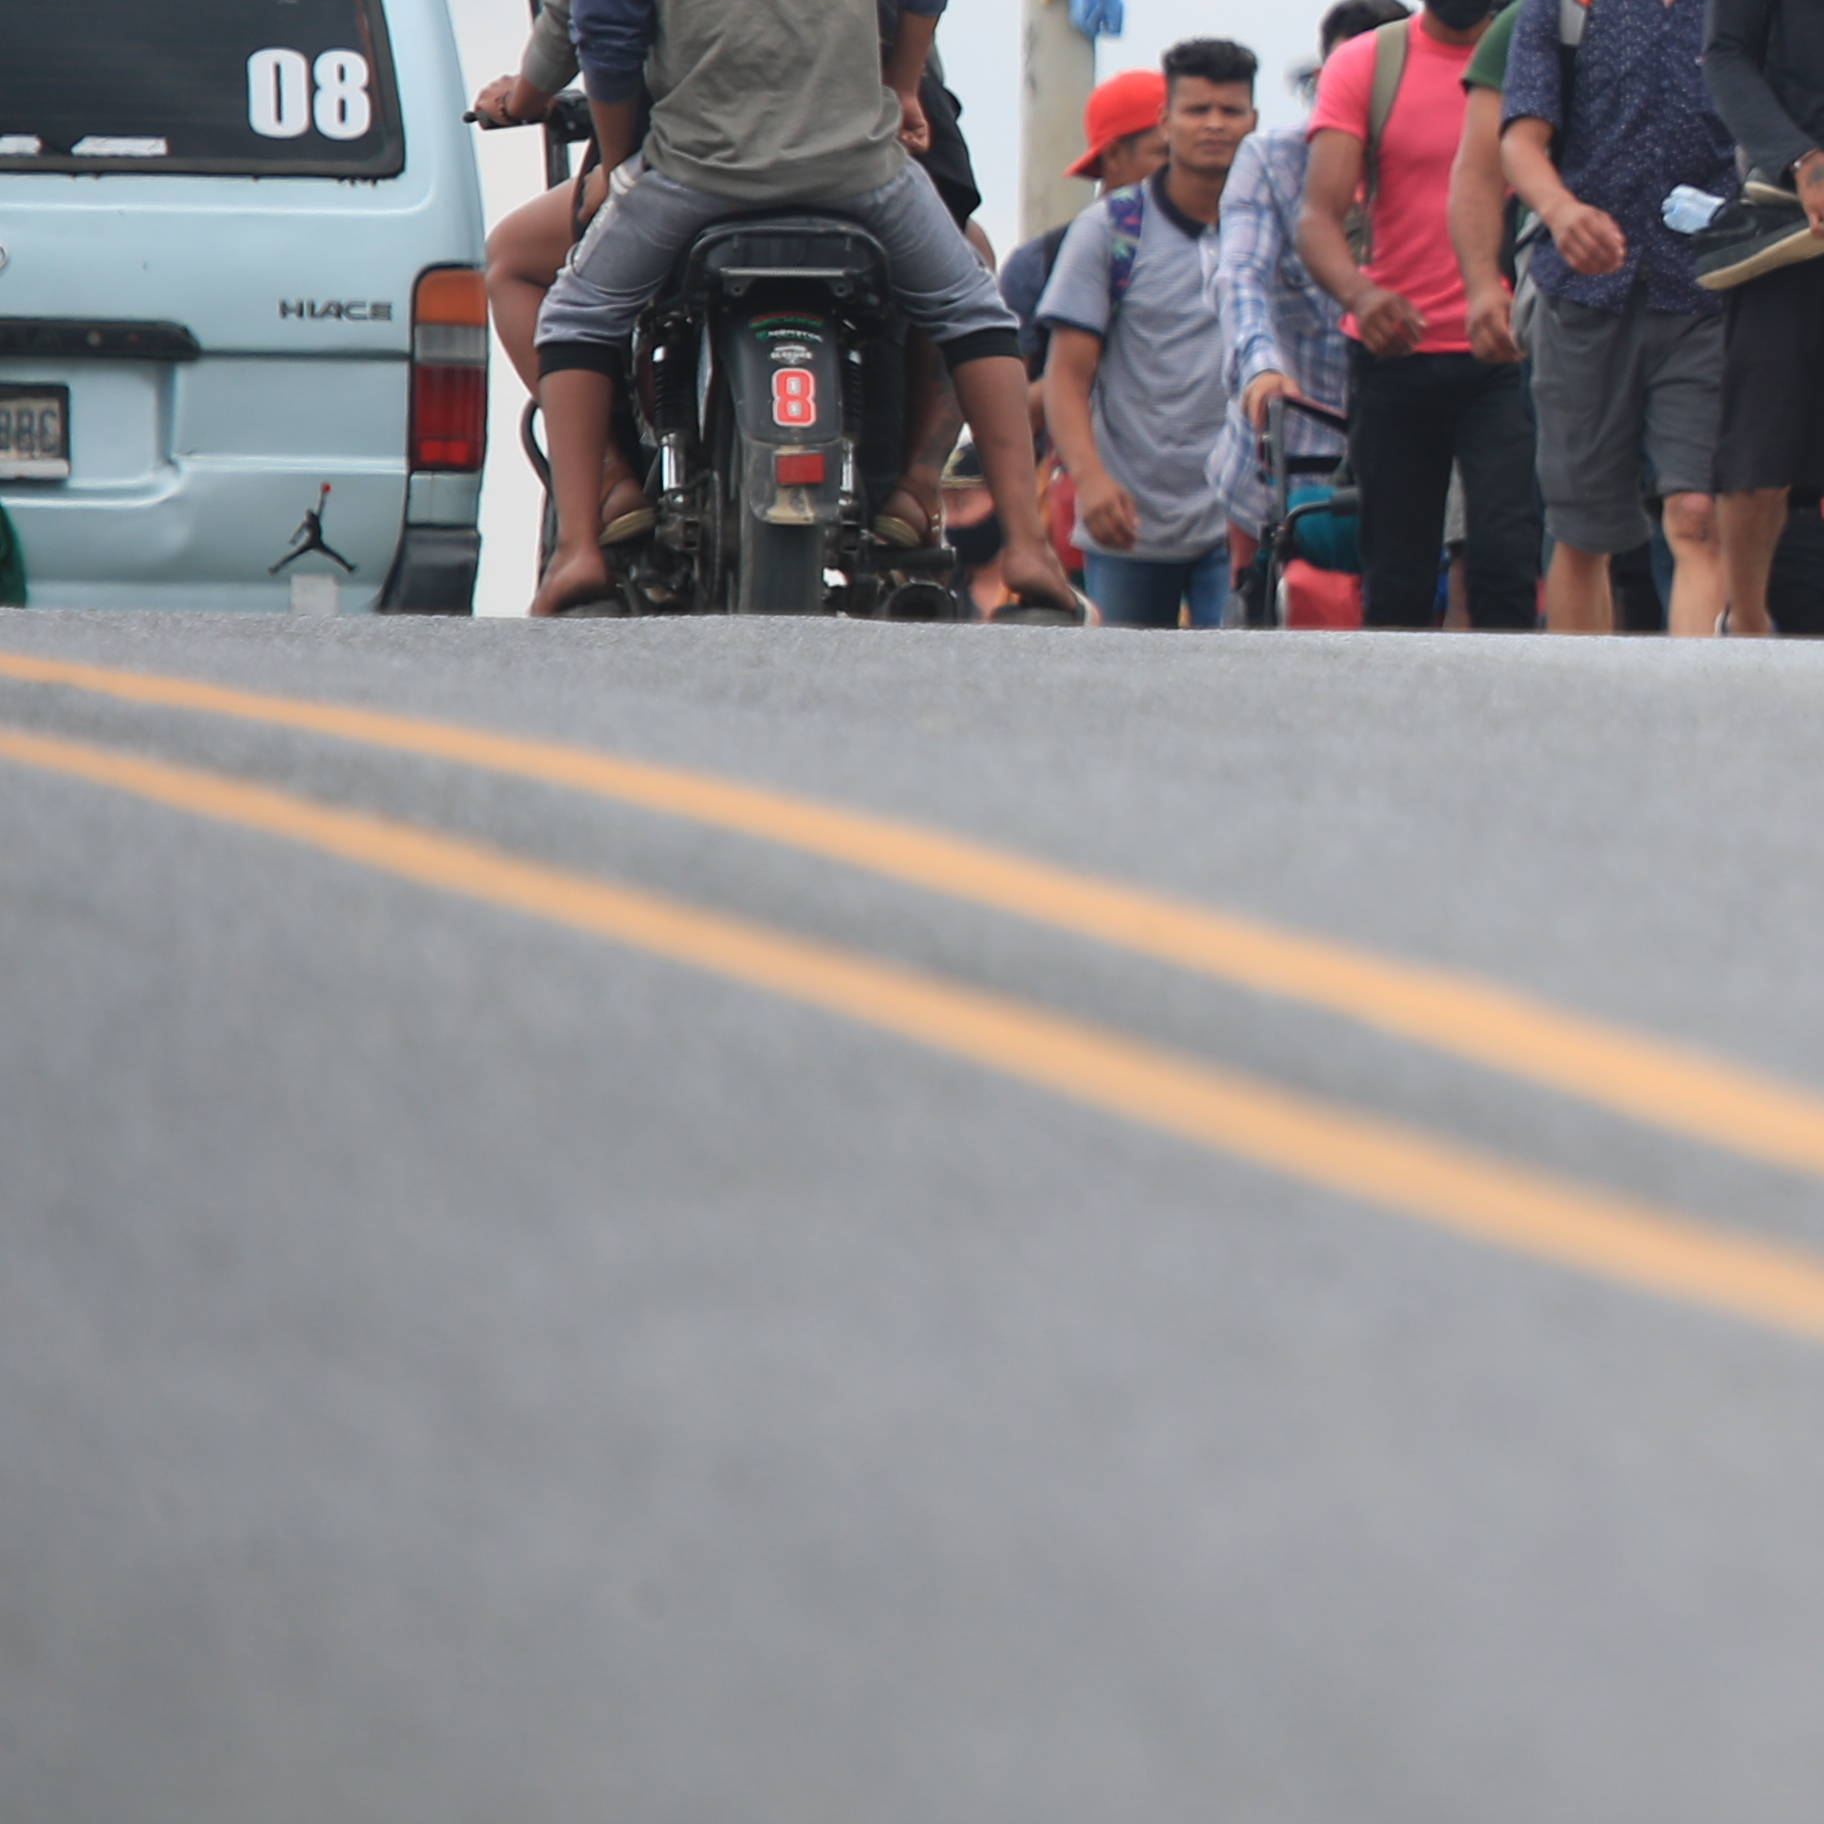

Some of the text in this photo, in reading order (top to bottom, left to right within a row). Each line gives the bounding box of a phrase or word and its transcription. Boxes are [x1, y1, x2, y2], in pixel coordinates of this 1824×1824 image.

[247, 46, 371, 141] 08
[279, 299, 392, 321] HIACE
[772, 368, 816, 427] 8
